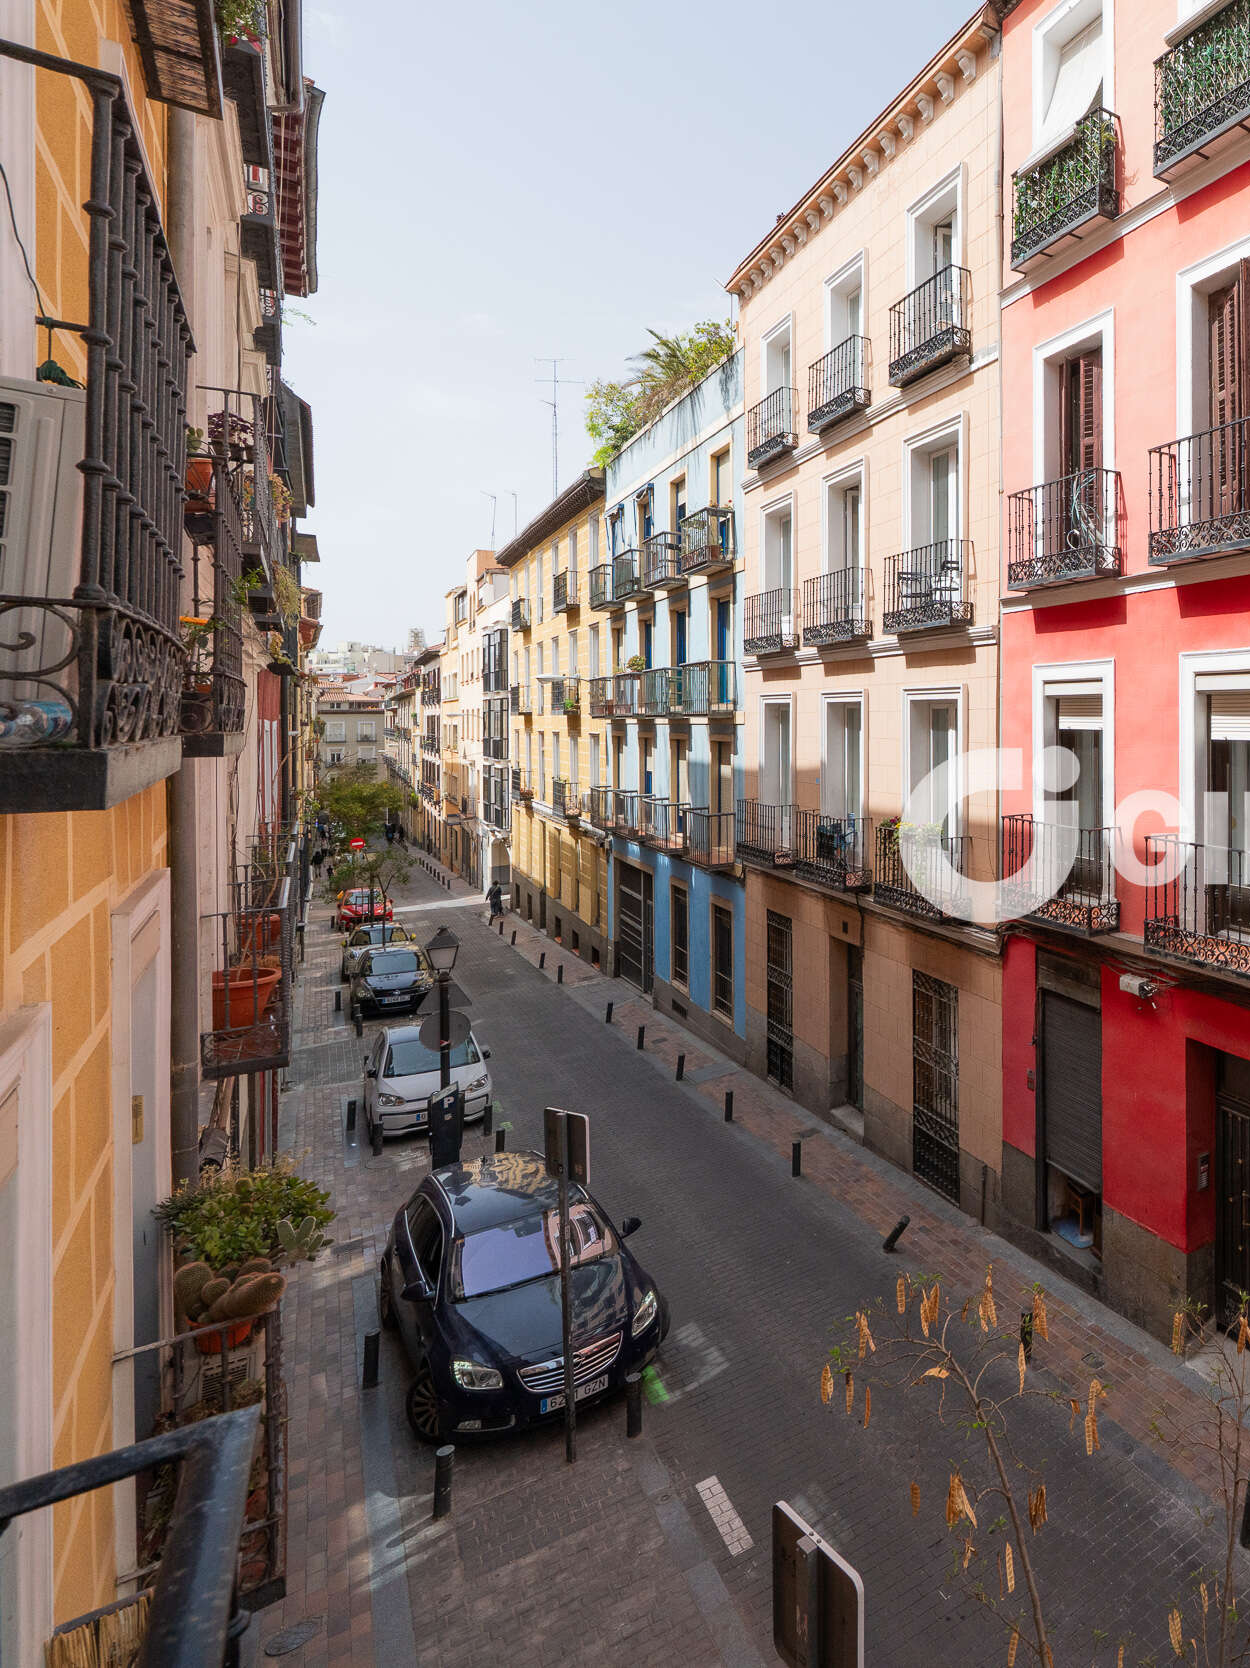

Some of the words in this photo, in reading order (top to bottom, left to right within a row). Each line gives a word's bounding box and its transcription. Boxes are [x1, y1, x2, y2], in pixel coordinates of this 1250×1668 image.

[443, 1095, 455, 1109] P
[550, 1388, 579, 1408] 621
[584, 1377, 606, 1395] GZN
